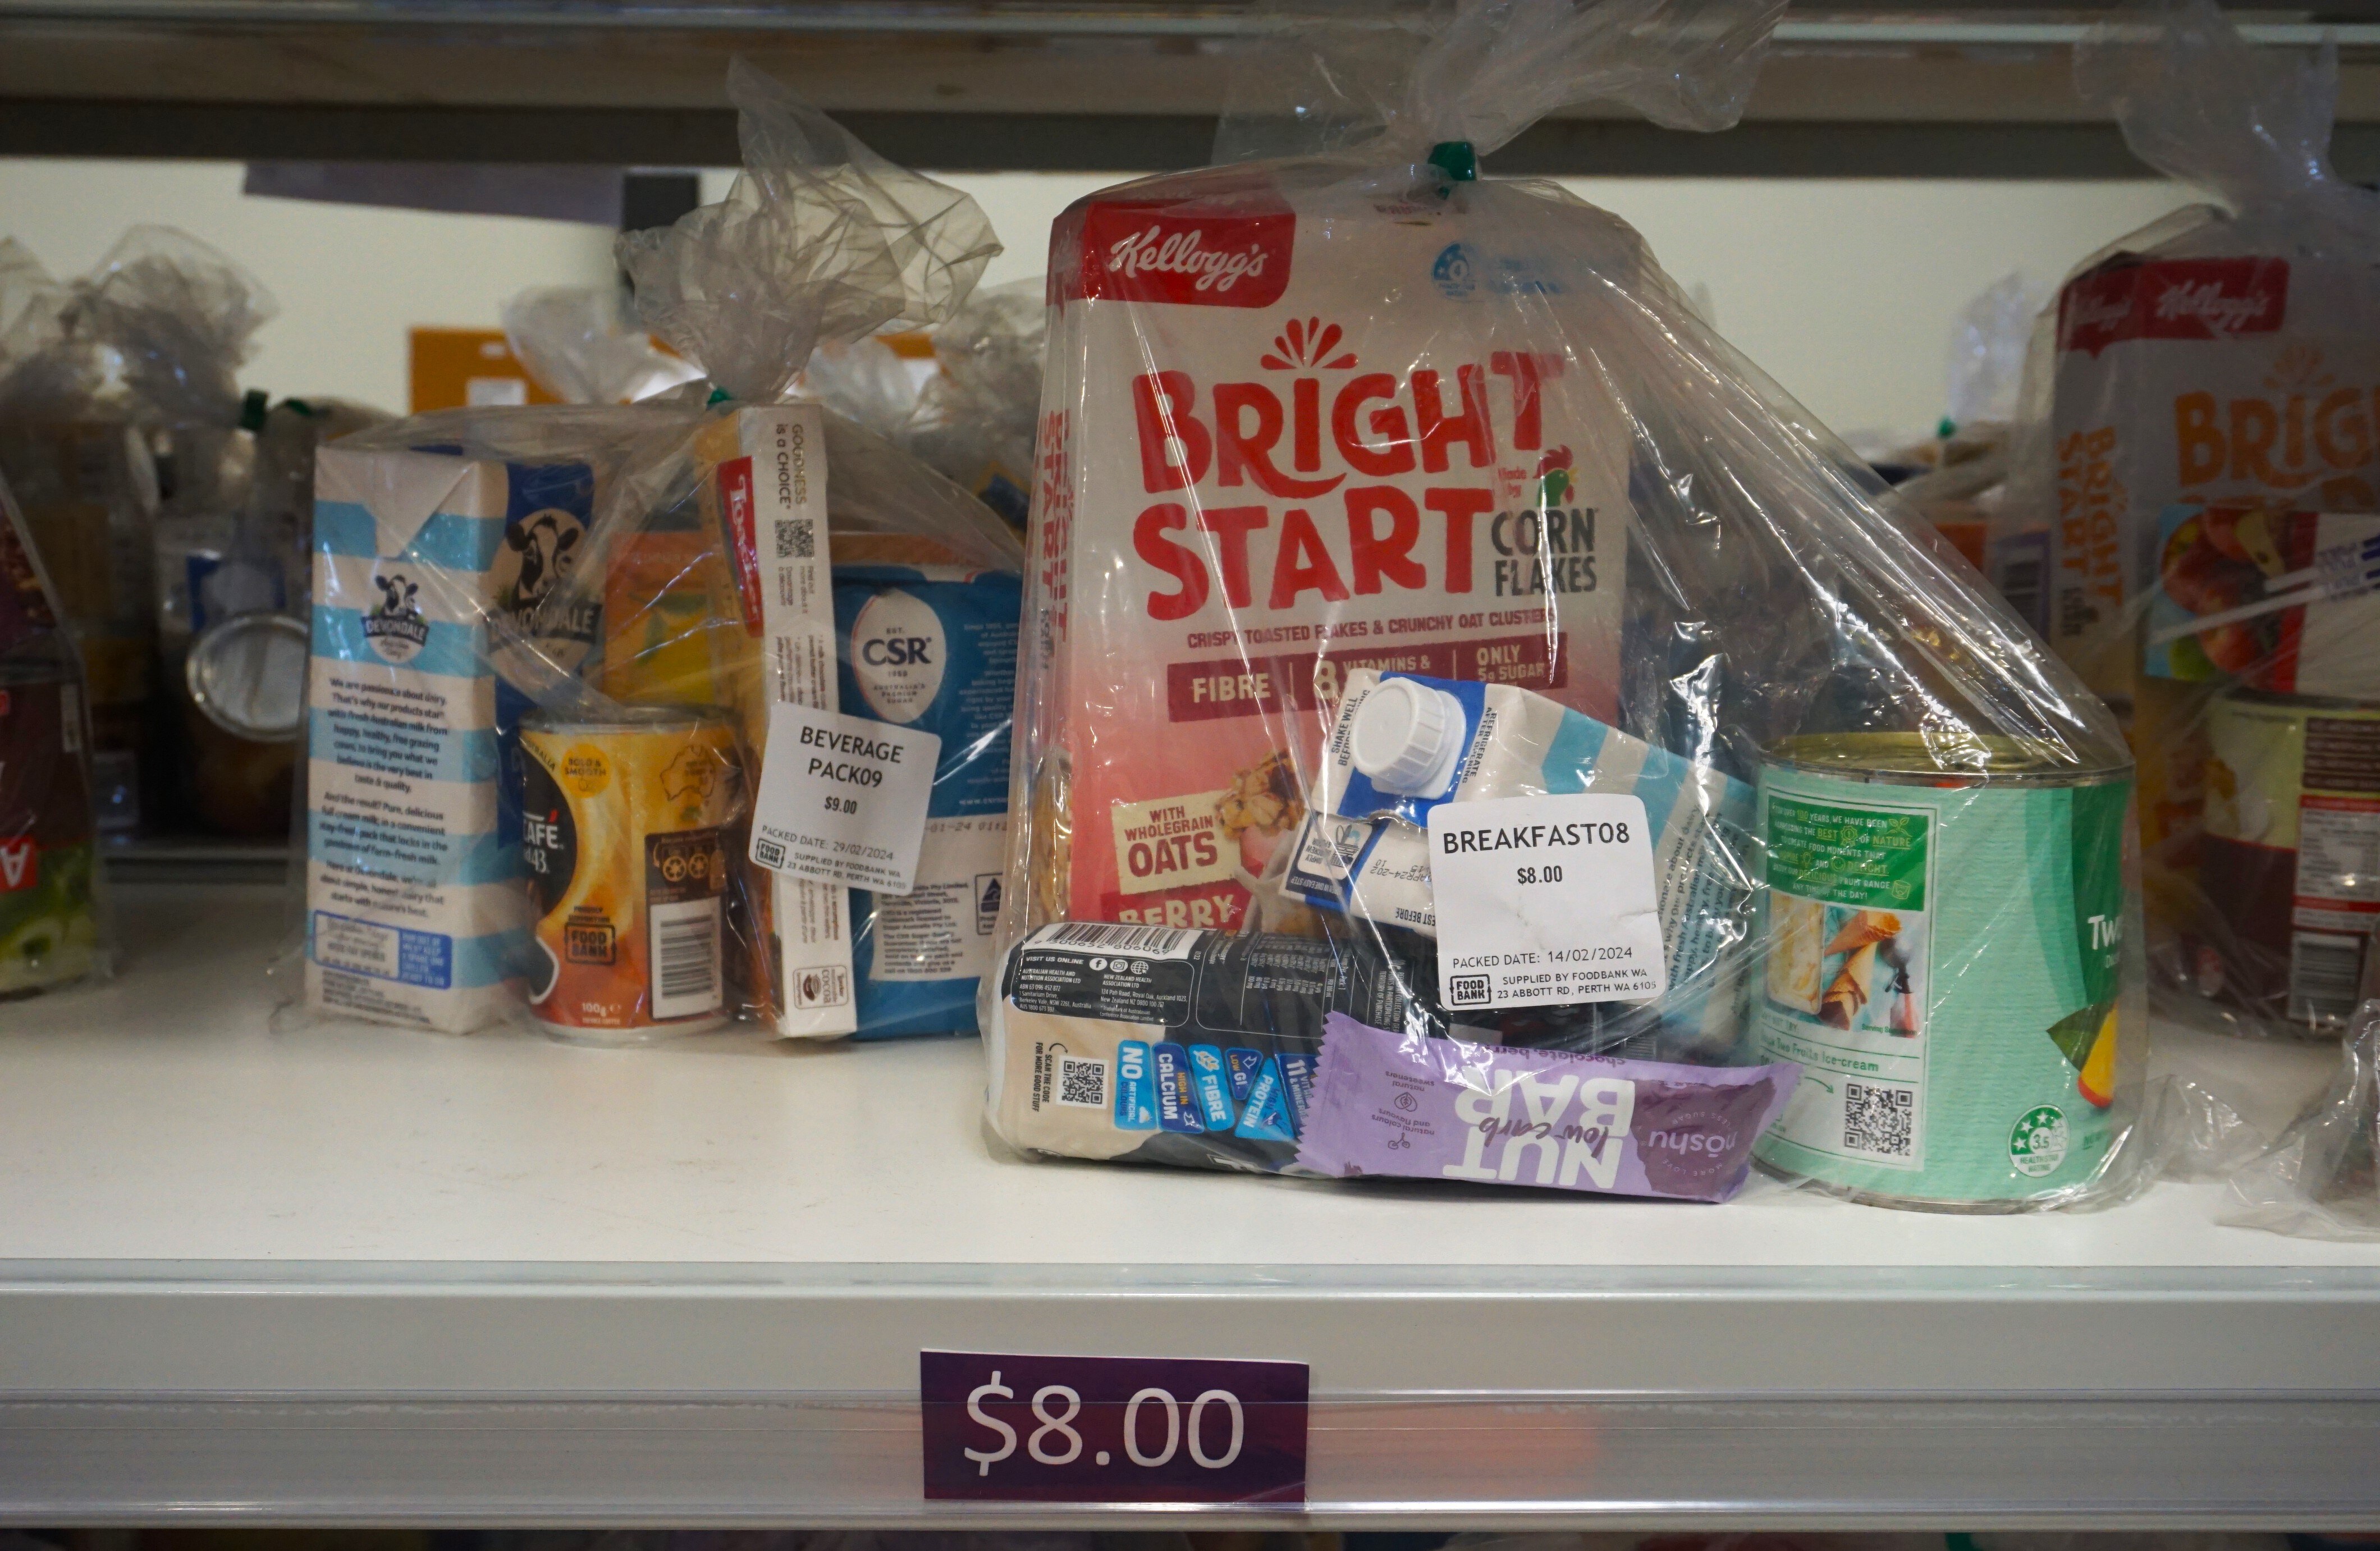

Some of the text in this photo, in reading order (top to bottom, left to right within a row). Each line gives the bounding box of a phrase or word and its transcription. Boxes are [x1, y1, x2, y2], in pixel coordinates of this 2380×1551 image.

[1108, 225, 1268, 291] Kellogg's
[1132, 351, 1566, 498] BRIGHT
[2175, 387, 2380, 488] BRIG
[1491, 507, 1596, 556] CORN
[1132, 485, 1495, 621] START
[1495, 556, 1597, 597] FLAKES
[366, 619, 425, 641] DEVONDALE
[1244, 625, 1310, 644] TOASTED
[1373, 620, 1385, 635] &
[1388, 615, 1454, 634] CRUNCHY
[1458, 612, 1485, 628] OAT
[862, 637, 931, 666] CSR
[1420, 655, 1431, 670] &
[1476, 644, 1521, 666] ONLY
[1312, 659, 1340, 698] 8
[1499, 662, 1545, 680] SUGAR
[1192, 673, 1271, 703] FIBRE
[1331, 697, 1358, 754] SHAKE WELL
[800, 726, 904, 763] BEVERAGE
[1462, 706, 1493, 784] AFTER OPENING
[1469, 712, 1497, 778] REFRIGERATE
[808, 758, 883, 787] PACK09
[824, 795, 857, 815] $9.00
[1149, 805, 1186, 823] WITH
[1124, 816, 1214, 841] WHOLEGRAIN
[1845, 817, 1865, 826] HAVE
[1866, 818, 1887, 828] BEEN
[762, 825, 894, 861] PACKED DATE: 29/02/2024
[1444, 822, 1630, 854] BREAKFAST08
[1804, 826, 1911, 847] THE BEST NATURE
[759, 851, 779, 863] BANK
[761, 843, 780, 855] FOOD
[1128, 831, 1218, 878] OATS
[1809, 844, 1862, 858] FOOD MOMENTS
[795, 852, 832, 866] SUPPLIED
[846, 862, 886, 876] FOODBANK
[888, 870, 900, 878] WA
[799, 864, 831, 876] ABBOTT
[846, 873, 870, 883] PERTH
[872, 877, 885, 886] WA
[1517, 865, 1563, 885] $8.00
[1291, 876, 1305, 886] STEP
[1839, 877, 1891, 889] FRUIT RANGE
[1833, 889, 1868, 899] THE DAY!
[1119, 894, 1235, 929] BERRY
[1395, 907, 1422, 923] BEFORE
[571, 930, 607, 944] FOOD
[1453, 946, 1633, 969] PACKED DATE: 14/02/2024
[1457, 979, 1484, 990] FOOD
[1503, 968, 1647, 986] SUPPLIED BY FOODBANK WA
[1111, 996, 1129, 1005] Zealand
[1133, 991, 1145, 999] Royal
[1457, 989, 1485, 1000] BANK
[1497, 981, 1656, 999] 23 ABBOTT RD, PERTH WA 6105
[1374, 999, 1384, 1026] PURCHASE
[1121, 1047, 1143, 1079] NO
[1229, 1054, 1239, 1072] LOW
[1286, 1059, 1306, 1076] 11
[1792, 1042, 1879, 1072] Fruits Ice-cream
[1033, 1073, 1042, 1088] GOOD
[1158, 1053, 1178, 1120] CALCIUM
[1177, 1072, 1188, 1105] HIGH IN
[1233, 1072, 1247, 1087] GI
[1385, 1070, 1435, 1087] sweeteners
[1392, 1081, 1425, 1092] natural
[1032, 1089, 1041, 1113] STUFF
[1042, 1086, 1051, 1103] CODE
[1128, 1081, 1137, 1123] ARTIFICIAL
[1201, 1075, 1227, 1123] FIBRE
[1242, 1073, 1274, 1130] PROTEIN
[1455, 1070, 1636, 1138] BAR
[1371, 1114, 1435, 1137] natural colours
[1378, 1109, 1409, 1122] flavours
[1669, 1109, 1706, 1126] SUGAR
[1479, 1115, 1610, 1159] low carb
[2032, 1133, 2050, 1150] 3.5
[1443, 1125, 1624, 1189] NUT
[1662, 1156, 1686, 1175] LOVE
[1693, 1161, 1723, 1178] MORE
[964, 1370, 1244, 1476] $8.00
